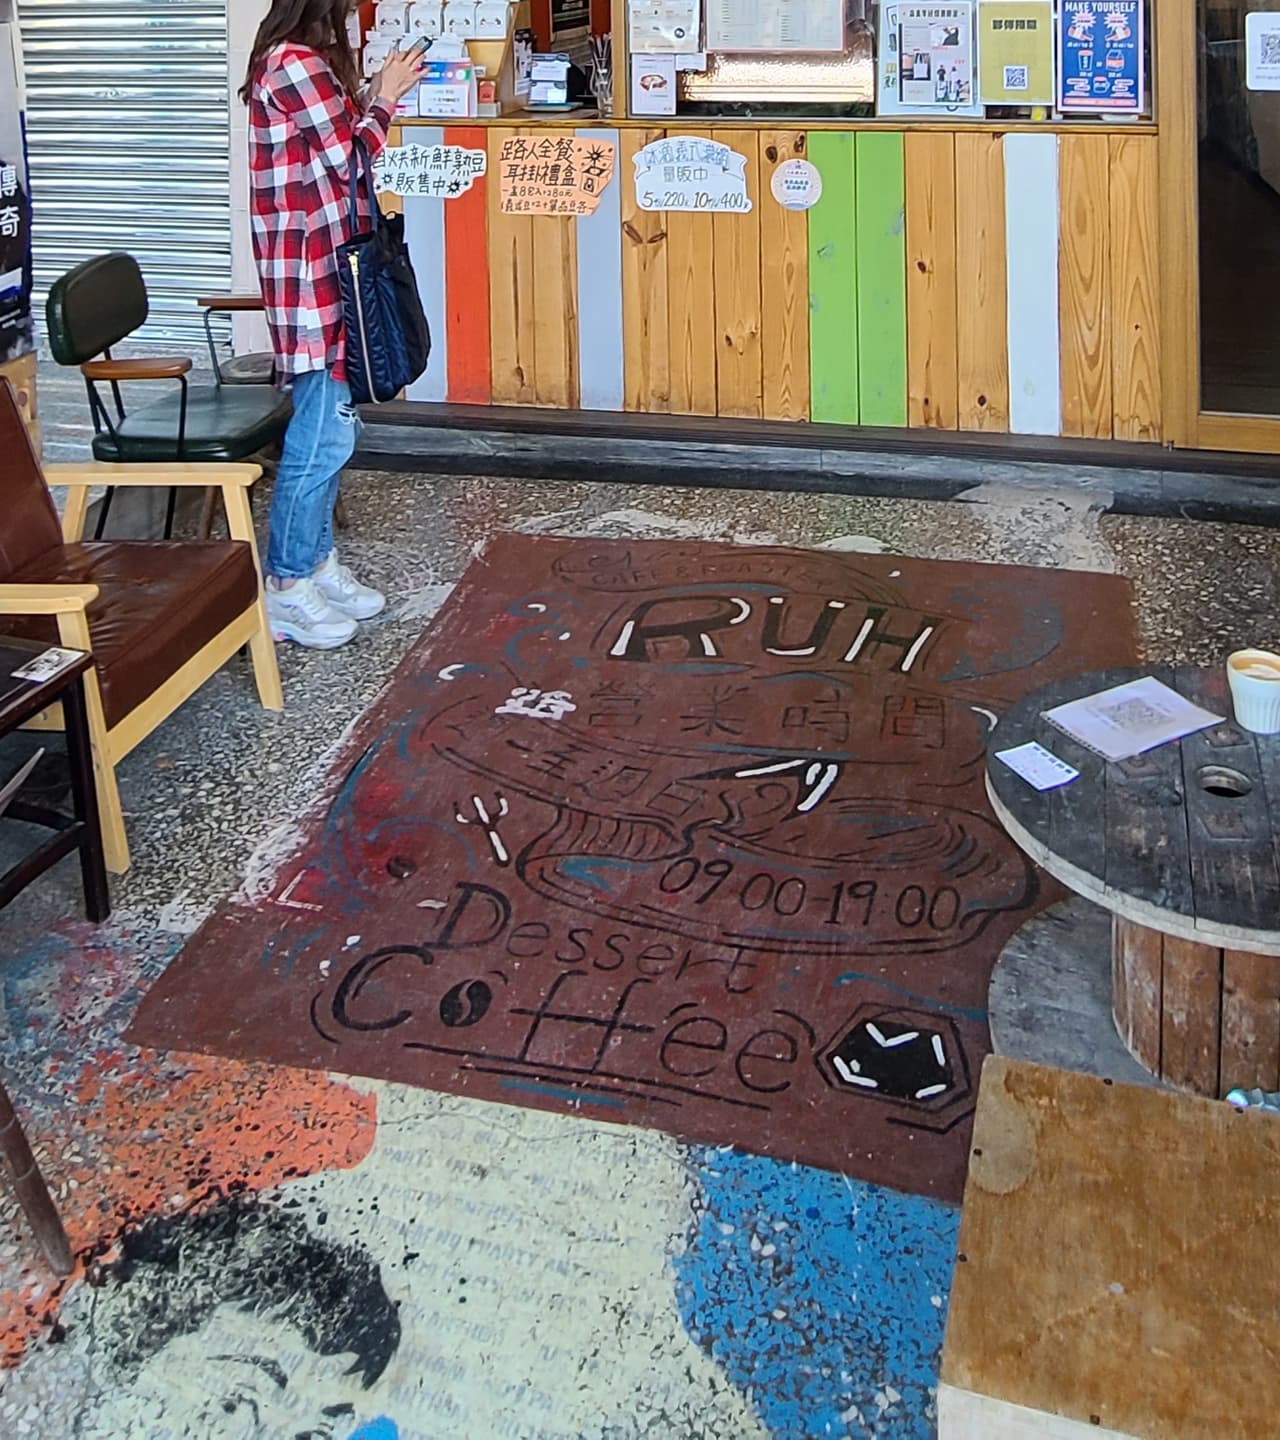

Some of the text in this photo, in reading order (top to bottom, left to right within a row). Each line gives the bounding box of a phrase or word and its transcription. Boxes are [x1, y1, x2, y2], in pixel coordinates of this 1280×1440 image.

[1064, 0, 1137, 13] MAKE YOURSELF
[500, 138, 576, 162] 路人全餐
[396, 170, 448, 195] 販售中
[503, 161, 578, 187] 耳掛禮盒
[607, 594, 946, 674] RUH
[587, 679, 947, 748] 營業時間
[422, 880, 759, 994] Dessert
[331, 944, 800, 1094] Coffee
